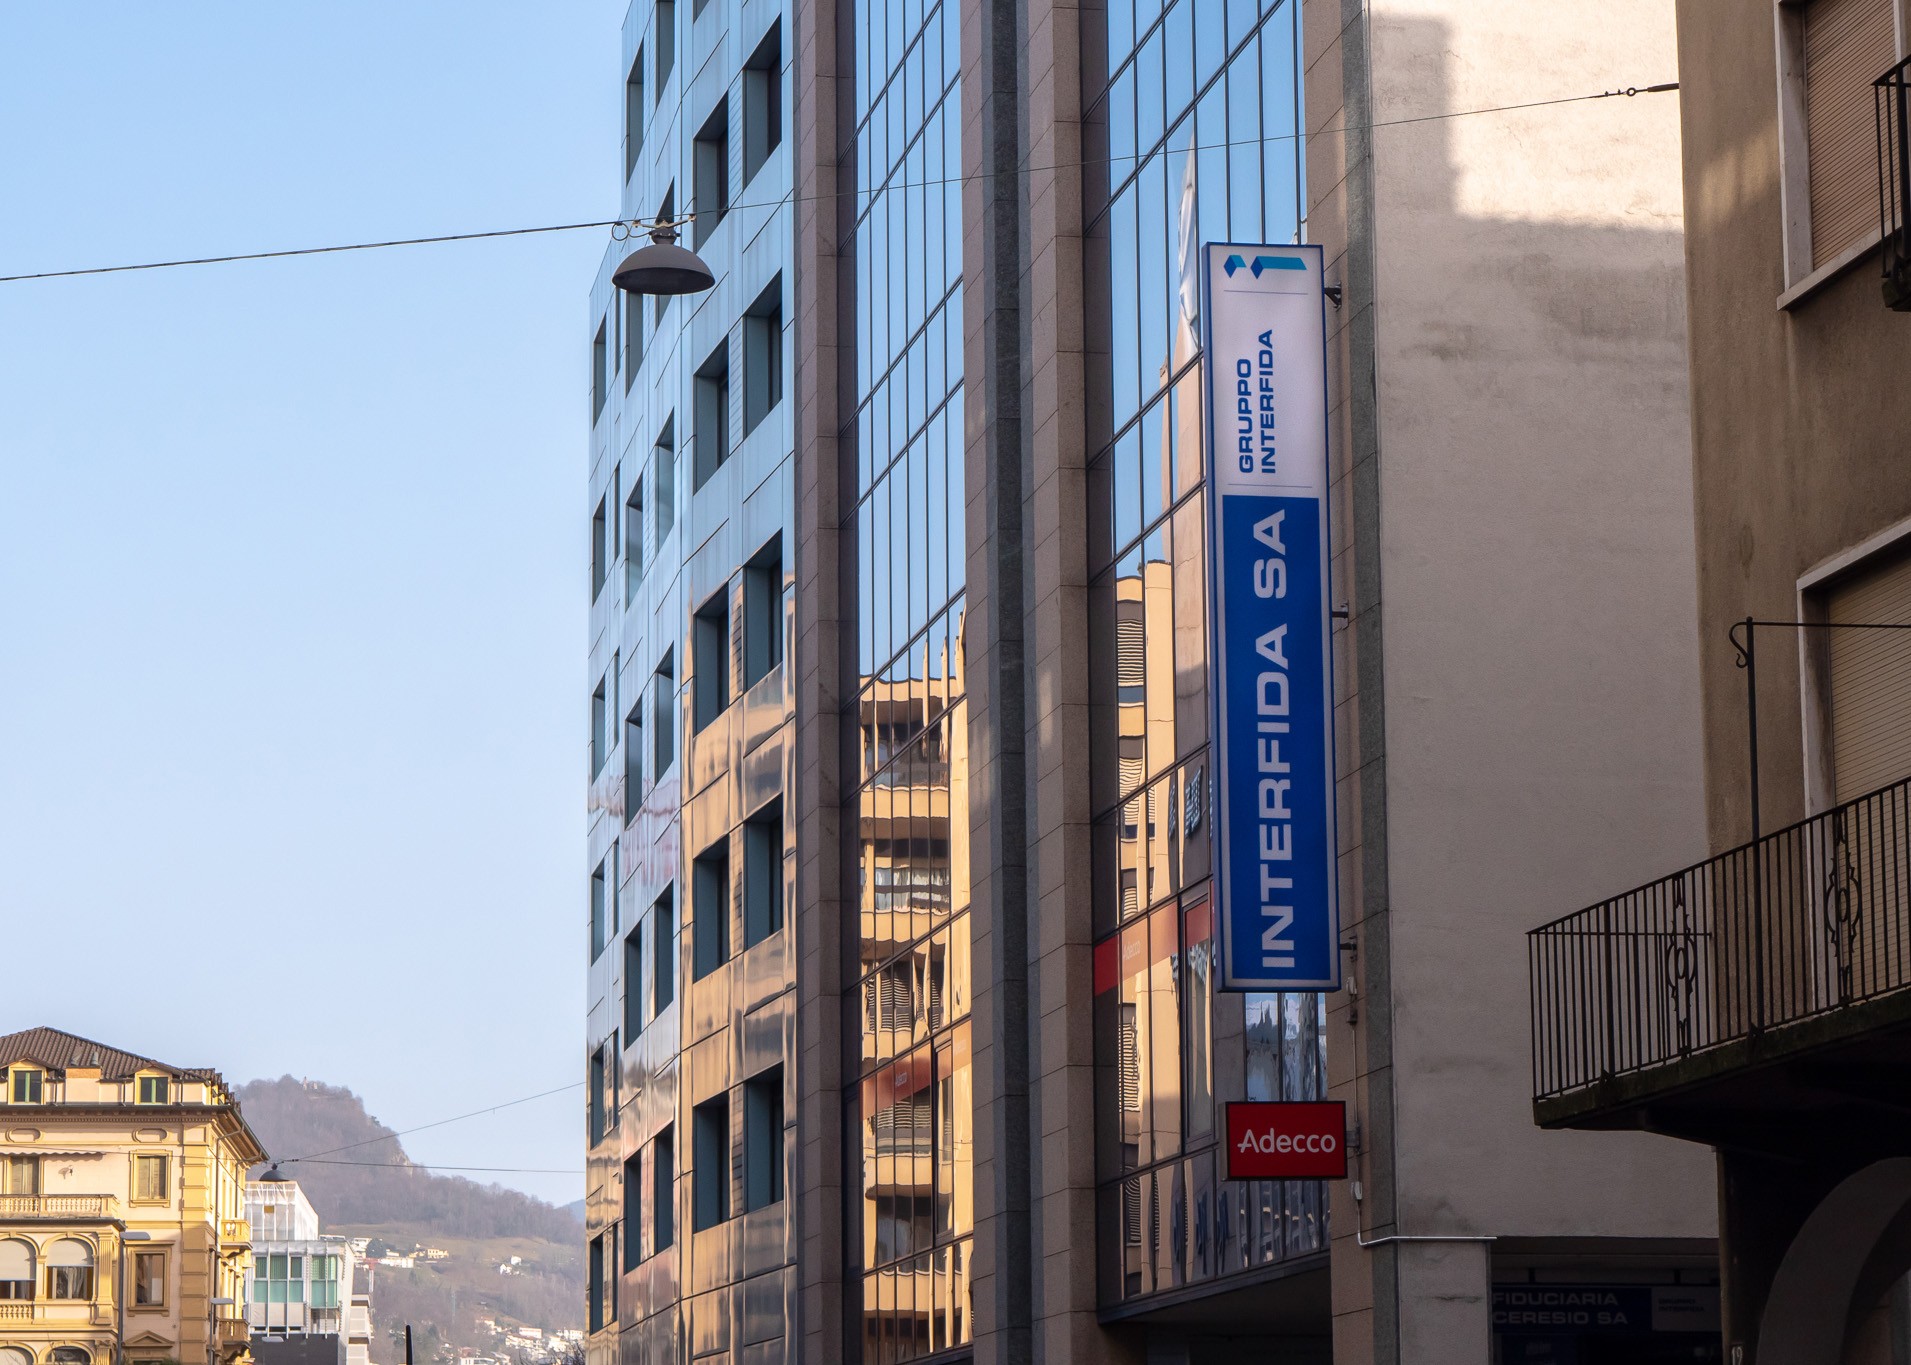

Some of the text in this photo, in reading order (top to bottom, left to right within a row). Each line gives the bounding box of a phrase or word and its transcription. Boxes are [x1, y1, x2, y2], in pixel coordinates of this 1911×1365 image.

[1236, 358, 1254, 474] GRUPPO
[1258, 329, 1276, 474] INTERFIDA
[1253, 509, 1295, 968] INTERFIDA SA
[1237, 1127, 1336, 1154] Adecco
[1492, 1292, 1619, 1306] FIDUCIARIA
[1492, 1311, 1628, 1325] CERESIO SA
